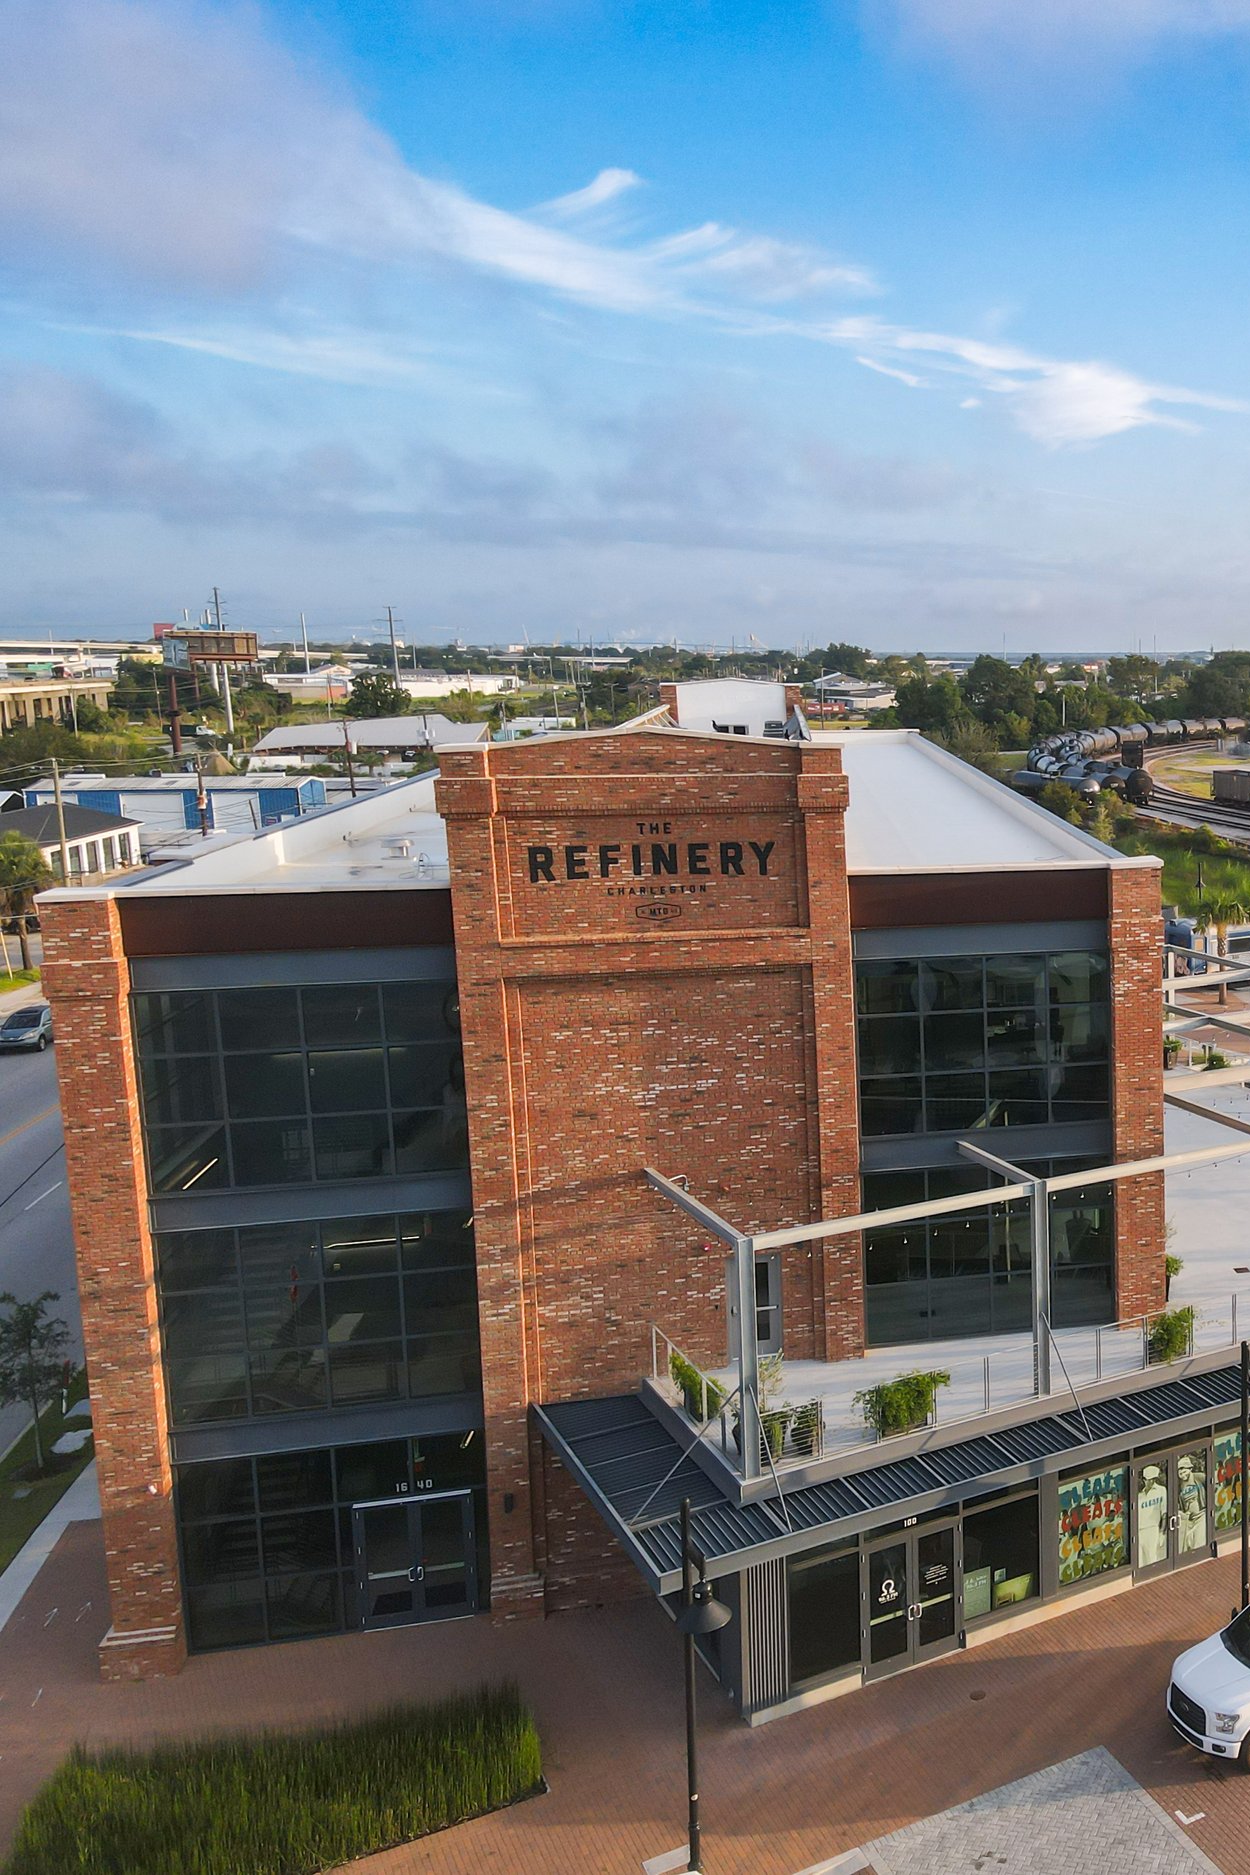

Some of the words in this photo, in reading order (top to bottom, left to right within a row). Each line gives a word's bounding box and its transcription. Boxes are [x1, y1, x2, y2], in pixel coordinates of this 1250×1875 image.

[636, 822, 672, 835] THE
[527, 841, 776, 883] REFINERY
[607, 884, 707, 896] CHARLESTON
[904, 1517, 917, 1528] 100
